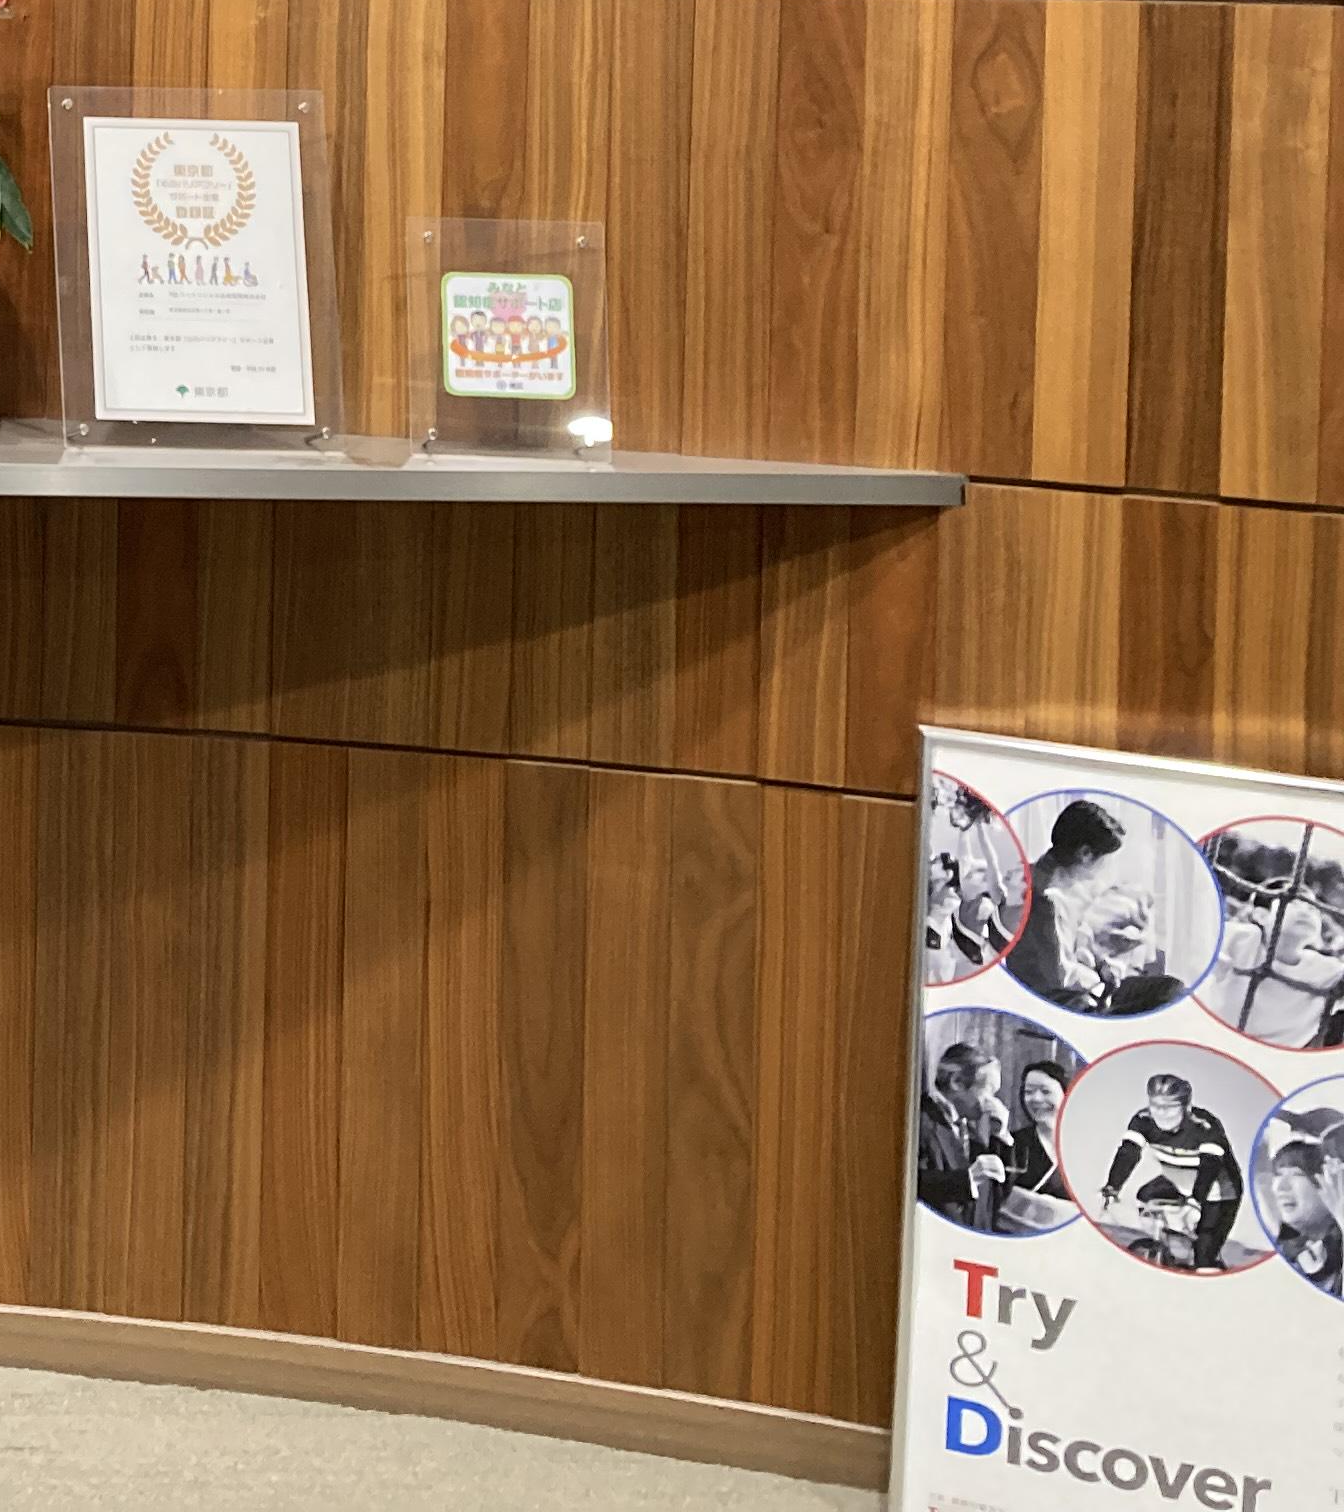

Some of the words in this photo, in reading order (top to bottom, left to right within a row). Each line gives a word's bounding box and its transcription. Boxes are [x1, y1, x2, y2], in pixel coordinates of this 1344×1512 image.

[953, 1259, 1079, 1350] Try
[949, 1330, 1010, 1404] &
[945, 1395, 1273, 1512] Discover
